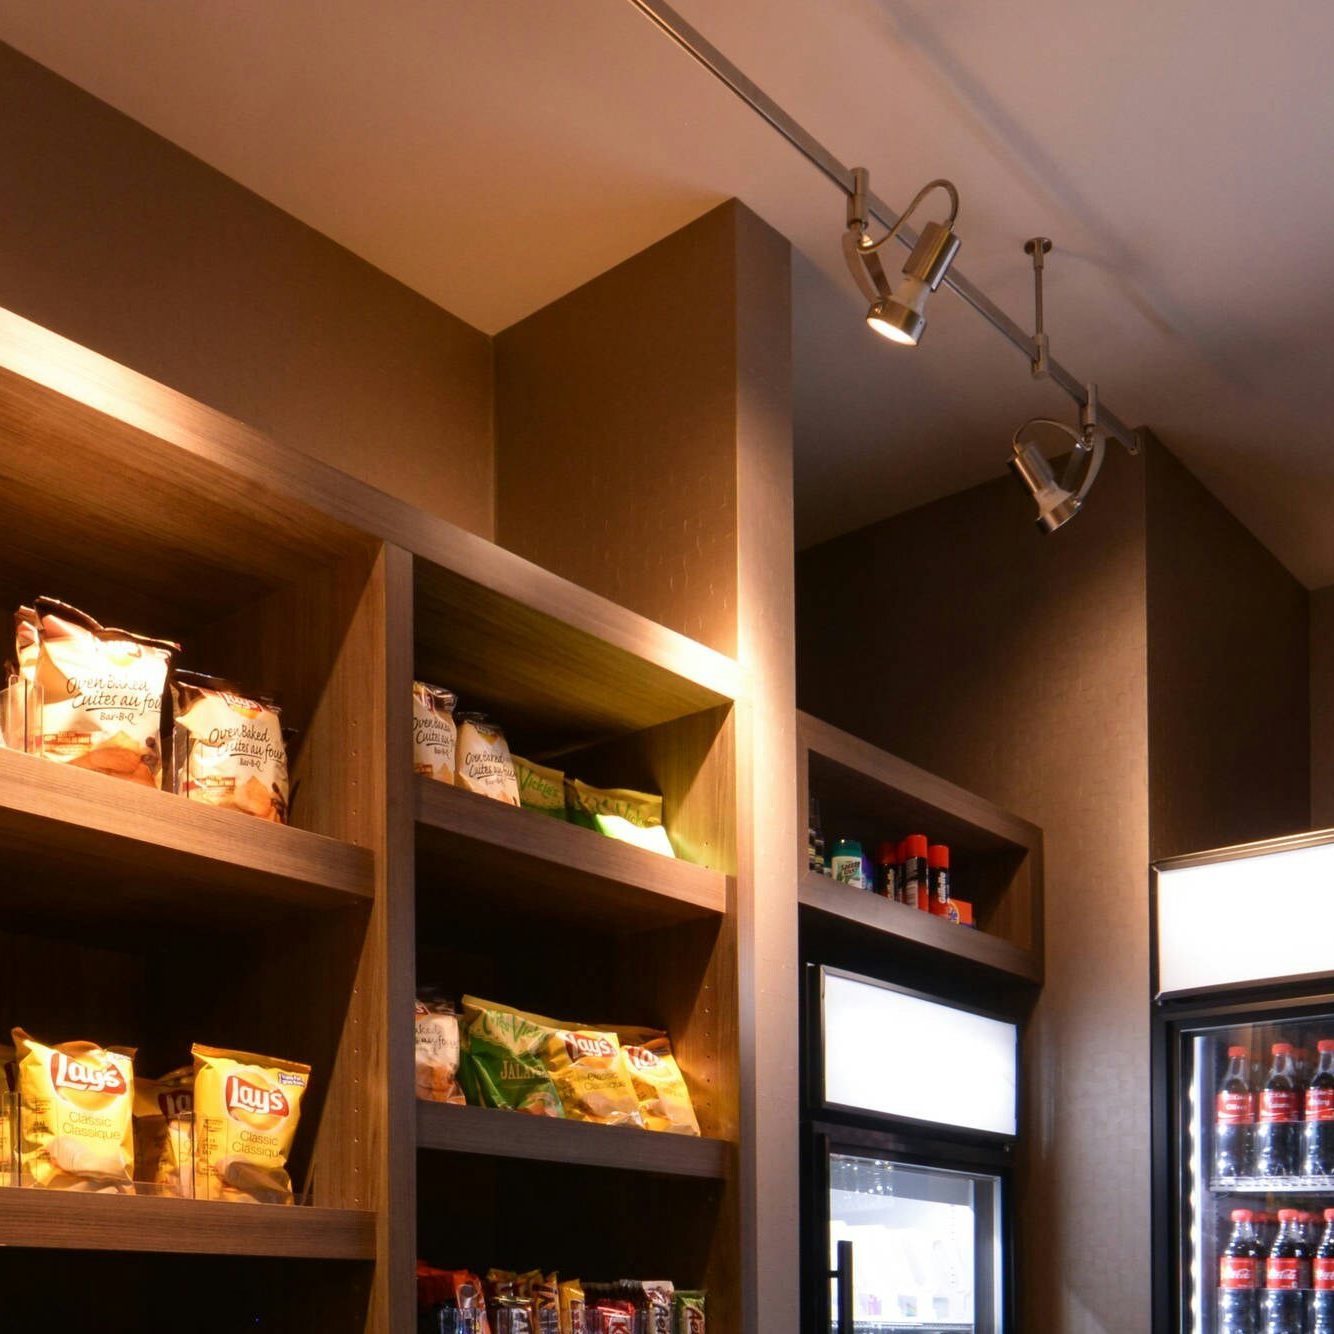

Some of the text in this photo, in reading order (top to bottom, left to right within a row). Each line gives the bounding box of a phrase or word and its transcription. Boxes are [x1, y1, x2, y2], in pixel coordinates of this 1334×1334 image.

[121, 696, 140, 708] au
[209, 724, 270, 745] Oven Baked
[251, 746, 265, 756] au
[53, 1054, 120, 1091] Lay's
[229, 1075, 285, 1114] Lay's
[69, 1111, 112, 1128] Classic
[62, 1122, 122, 1141] Classique
[239, 1130, 279, 1146] Classic
[232, 1142, 285, 1160] Classique
